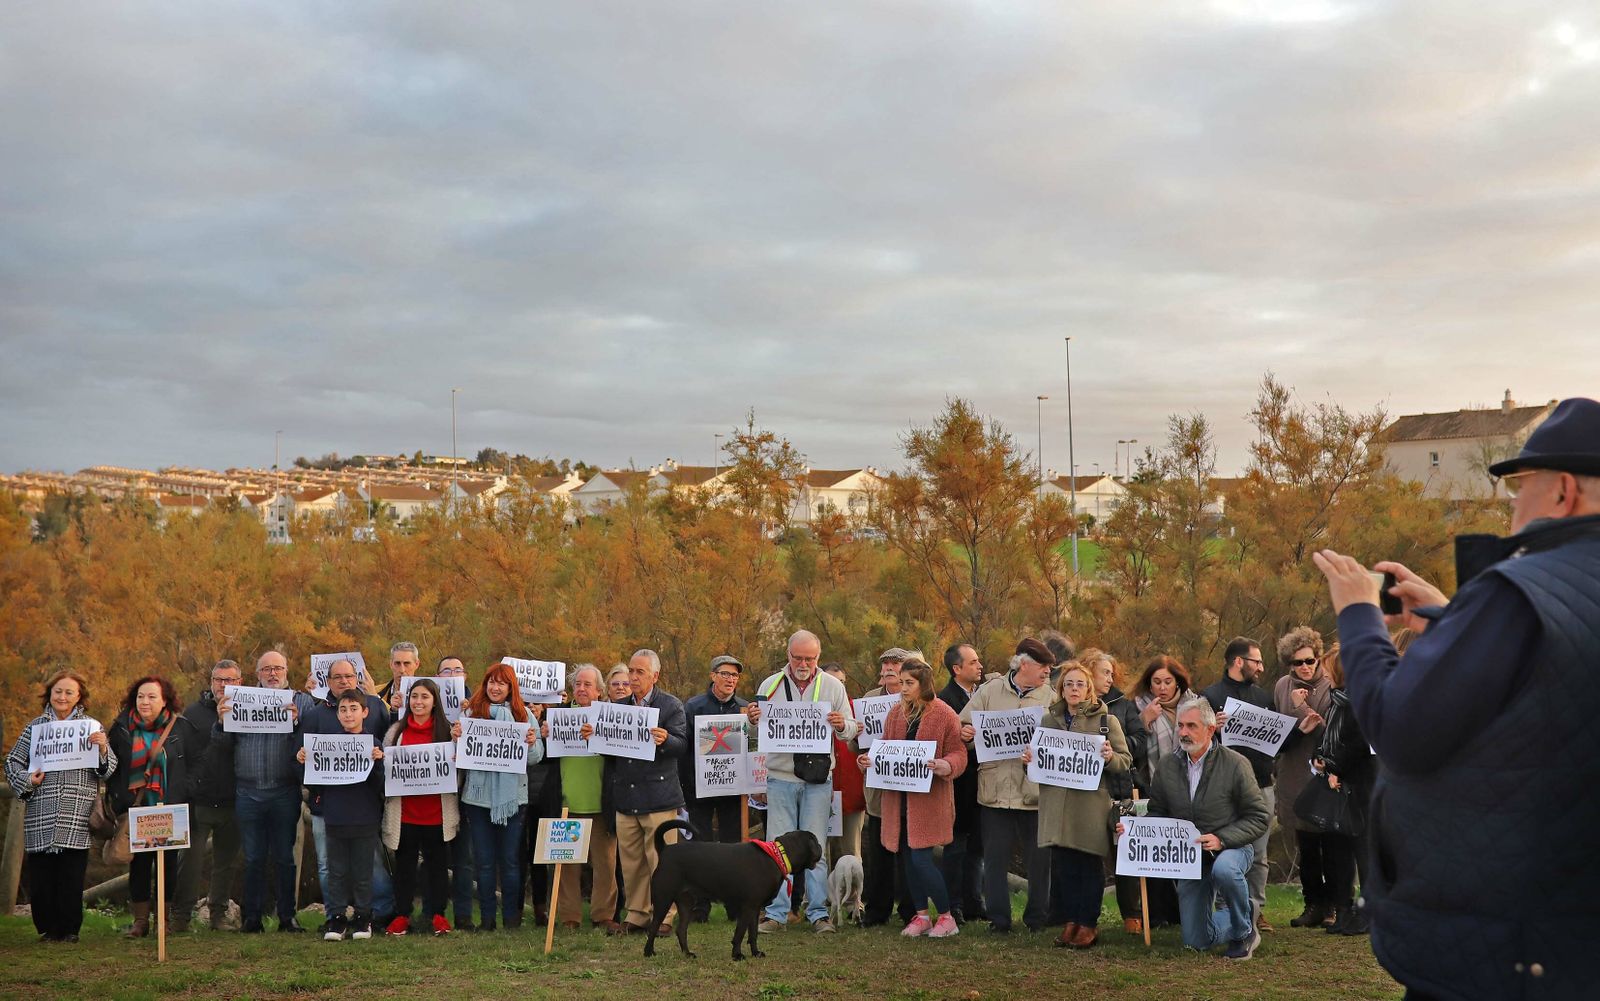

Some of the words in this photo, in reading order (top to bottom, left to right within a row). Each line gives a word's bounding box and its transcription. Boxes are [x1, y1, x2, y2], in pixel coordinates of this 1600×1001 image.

[316, 671, 328, 688] Si
[516, 663, 542, 677] lbero
[518, 675, 542, 690] uitran
[546, 678, 558, 691] NO
[232, 688, 256, 704] Zonas
[258, 691, 283, 706] verdes
[446, 696, 458, 708] NO
[232, 703, 248, 721] Sin
[252, 706, 288, 722] asfalto
[598, 705, 632, 726] Albero
[767, 704, 792, 719] Zonas
[795, 704, 821, 719] verdes
[862, 700, 886, 715] Zonas
[1232, 703, 1258, 722] Zonas
[1260, 715, 1286, 729] verdes
[553, 710, 588, 726] Albero
[865, 716, 882, 735] Sin
[980, 714, 1005, 728] Zonas
[1007, 711, 1036, 726] verdes
[39, 724, 74, 742] Albero
[467, 721, 492, 736] Zonas
[495, 724, 520, 739] verdes
[552, 728, 583, 744] Alquitra
[595, 723, 632, 741] Alquitran
[637, 729, 650, 743] NO
[768, 719, 785, 739] Sin
[789, 720, 826, 740] asfalto
[982, 730, 1002, 748] Sin
[1005, 726, 1035, 746] asfalt
[1224, 718, 1243, 733] Sin
[1242, 725, 1282, 744] asfalto
[35, 742, 73, 759] Alquitran
[79, 738, 92, 752] NO
[312, 737, 336, 752] Zonas
[338, 737, 364, 752] verdes
[466, 736, 483, 756] Sin
[486, 739, 524, 760] asfalto
[876, 743, 900, 755] Zonas
[903, 744, 927, 757] verdes
[1037, 730, 1064, 748] Zonas
[1067, 736, 1096, 752] verdes
[314, 752, 330, 771] Sin
[334, 753, 370, 772] asfalto
[392, 748, 430, 765] Albero
[1038, 748, 1054, 770] Sin
[1059, 752, 1100, 776] asfalto
[392, 765, 431, 782] Alquitran
[436, 762, 449, 777] NO
[875, 755, 890, 776] Sin
[894, 757, 929, 779] asfalto
[552, 821, 566, 829] NO
[566, 821, 580, 842] B
[1128, 820, 1156, 838] Zonas
[1159, 822, 1190, 839] verdes
[1128, 838, 1148, 862] Sin
[1153, 840, 1196, 864] asfalto
